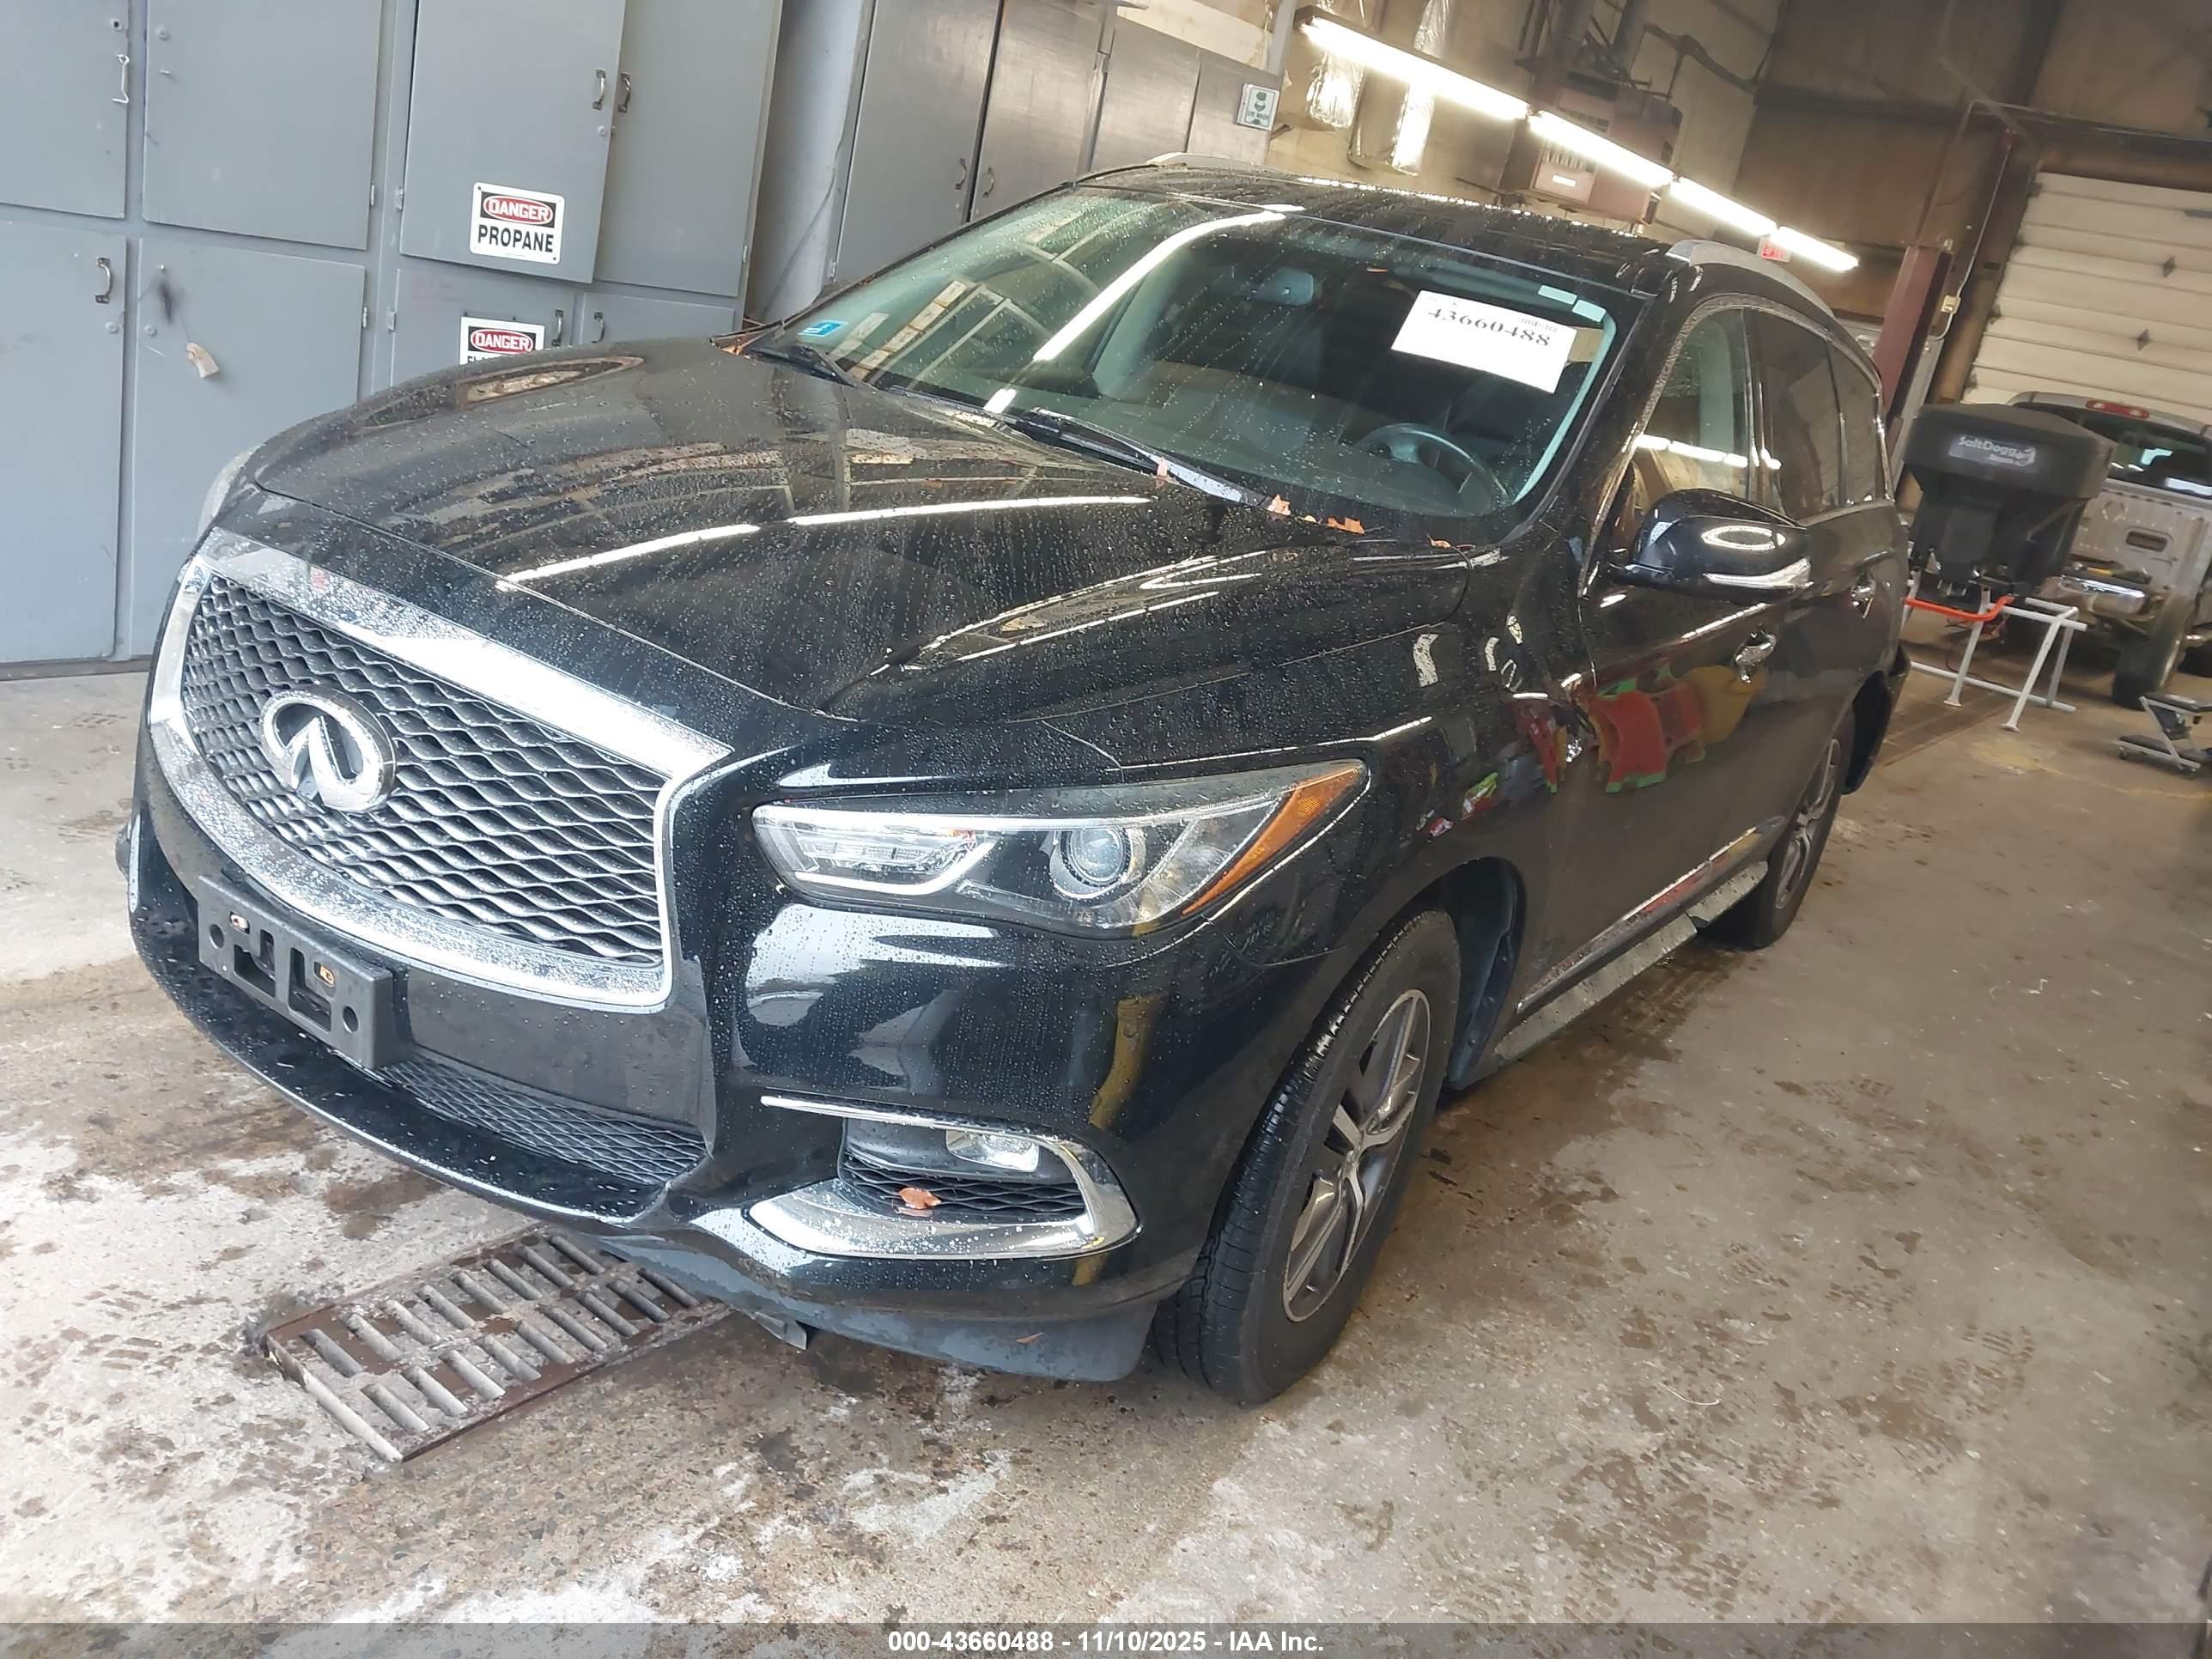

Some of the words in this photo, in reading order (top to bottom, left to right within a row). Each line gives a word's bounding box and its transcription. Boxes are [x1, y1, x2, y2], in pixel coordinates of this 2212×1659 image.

[489, 198, 550, 222] DANGER
[477, 224, 554, 253] PROPANE
[1428, 308, 1551, 346] 43660488
[475, 332, 531, 352] DANGER
